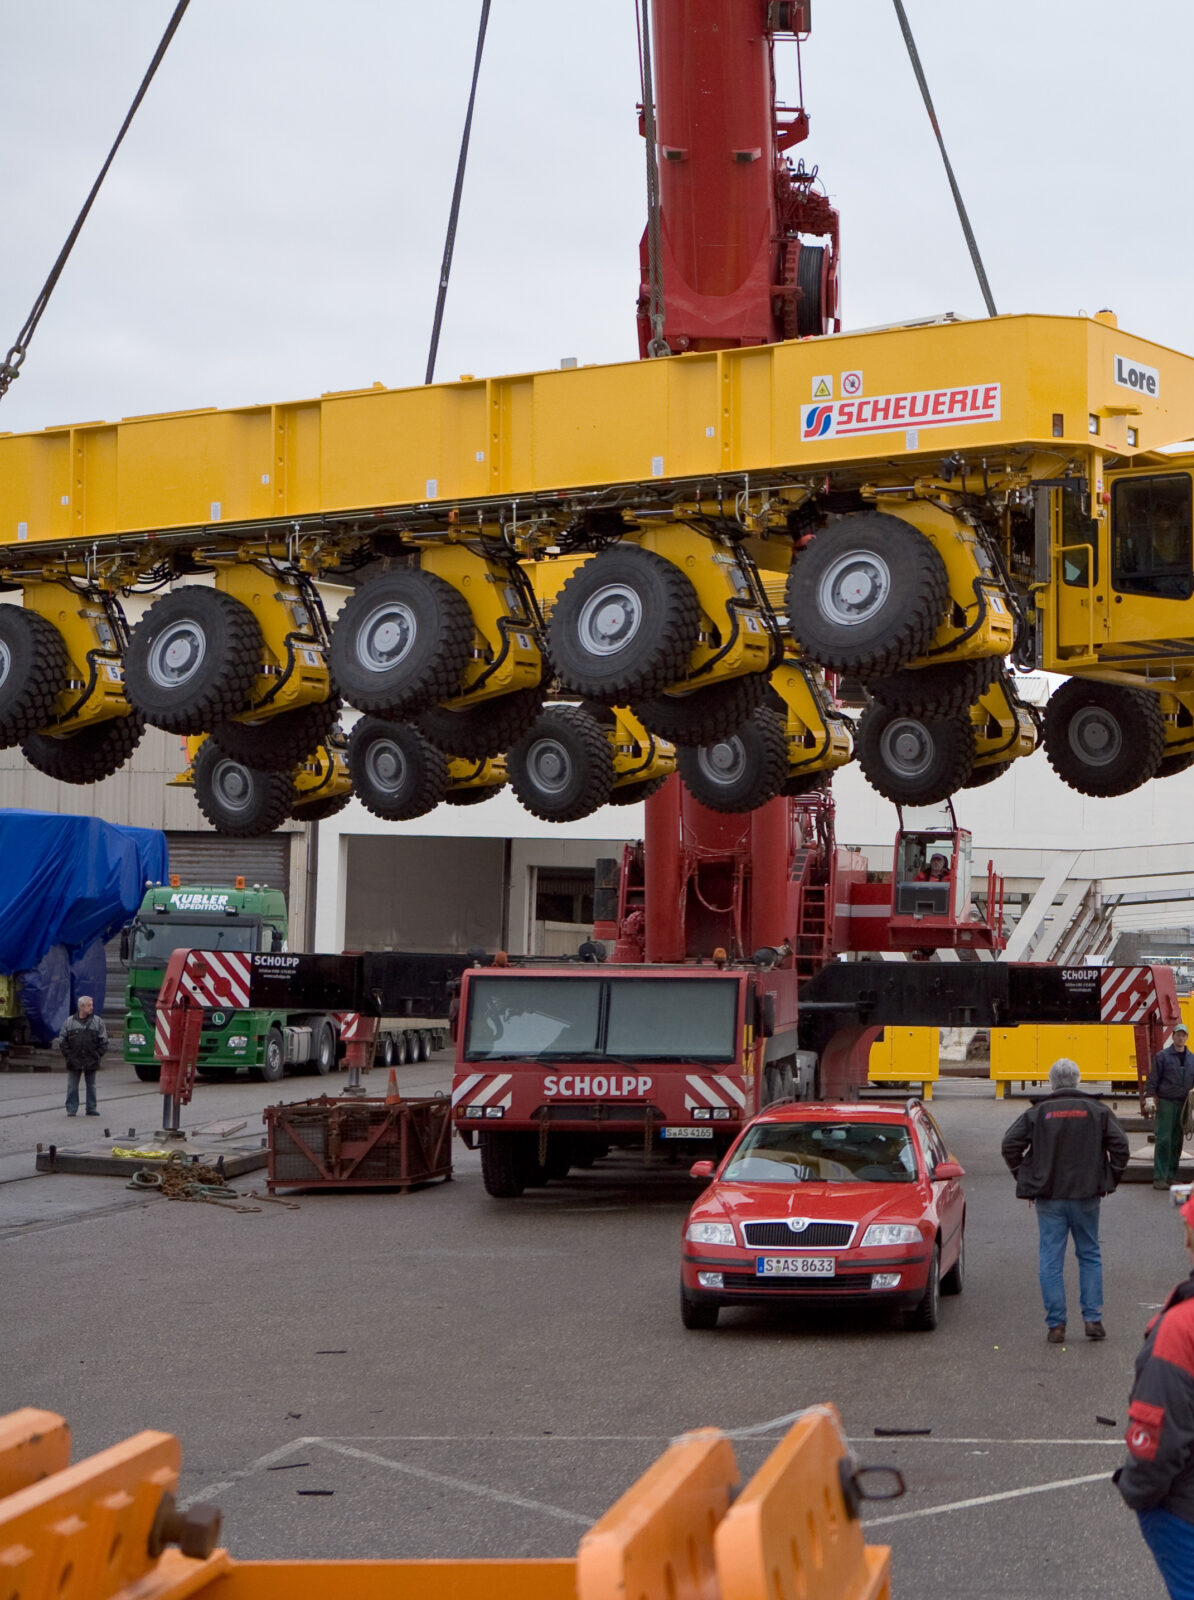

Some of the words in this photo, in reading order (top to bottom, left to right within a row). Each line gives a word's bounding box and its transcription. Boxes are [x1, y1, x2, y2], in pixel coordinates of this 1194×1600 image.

[1117, 357, 1157, 395] Lore
[836, 386, 998, 426] SCHEUERLE
[748, 617, 758, 631] 2
[519, 634, 529, 649] 3
[307, 651, 316, 665] 4
[109, 666, 119, 680] 5
[178, 903, 225, 911] SPEDITION
[254, 955, 299, 967] SCHOLPP
[1061, 969, 1099, 980] SCHOLPP
[543, 1075, 653, 1096] SCHOLPP
[801, 1259, 833, 1272] 8633
